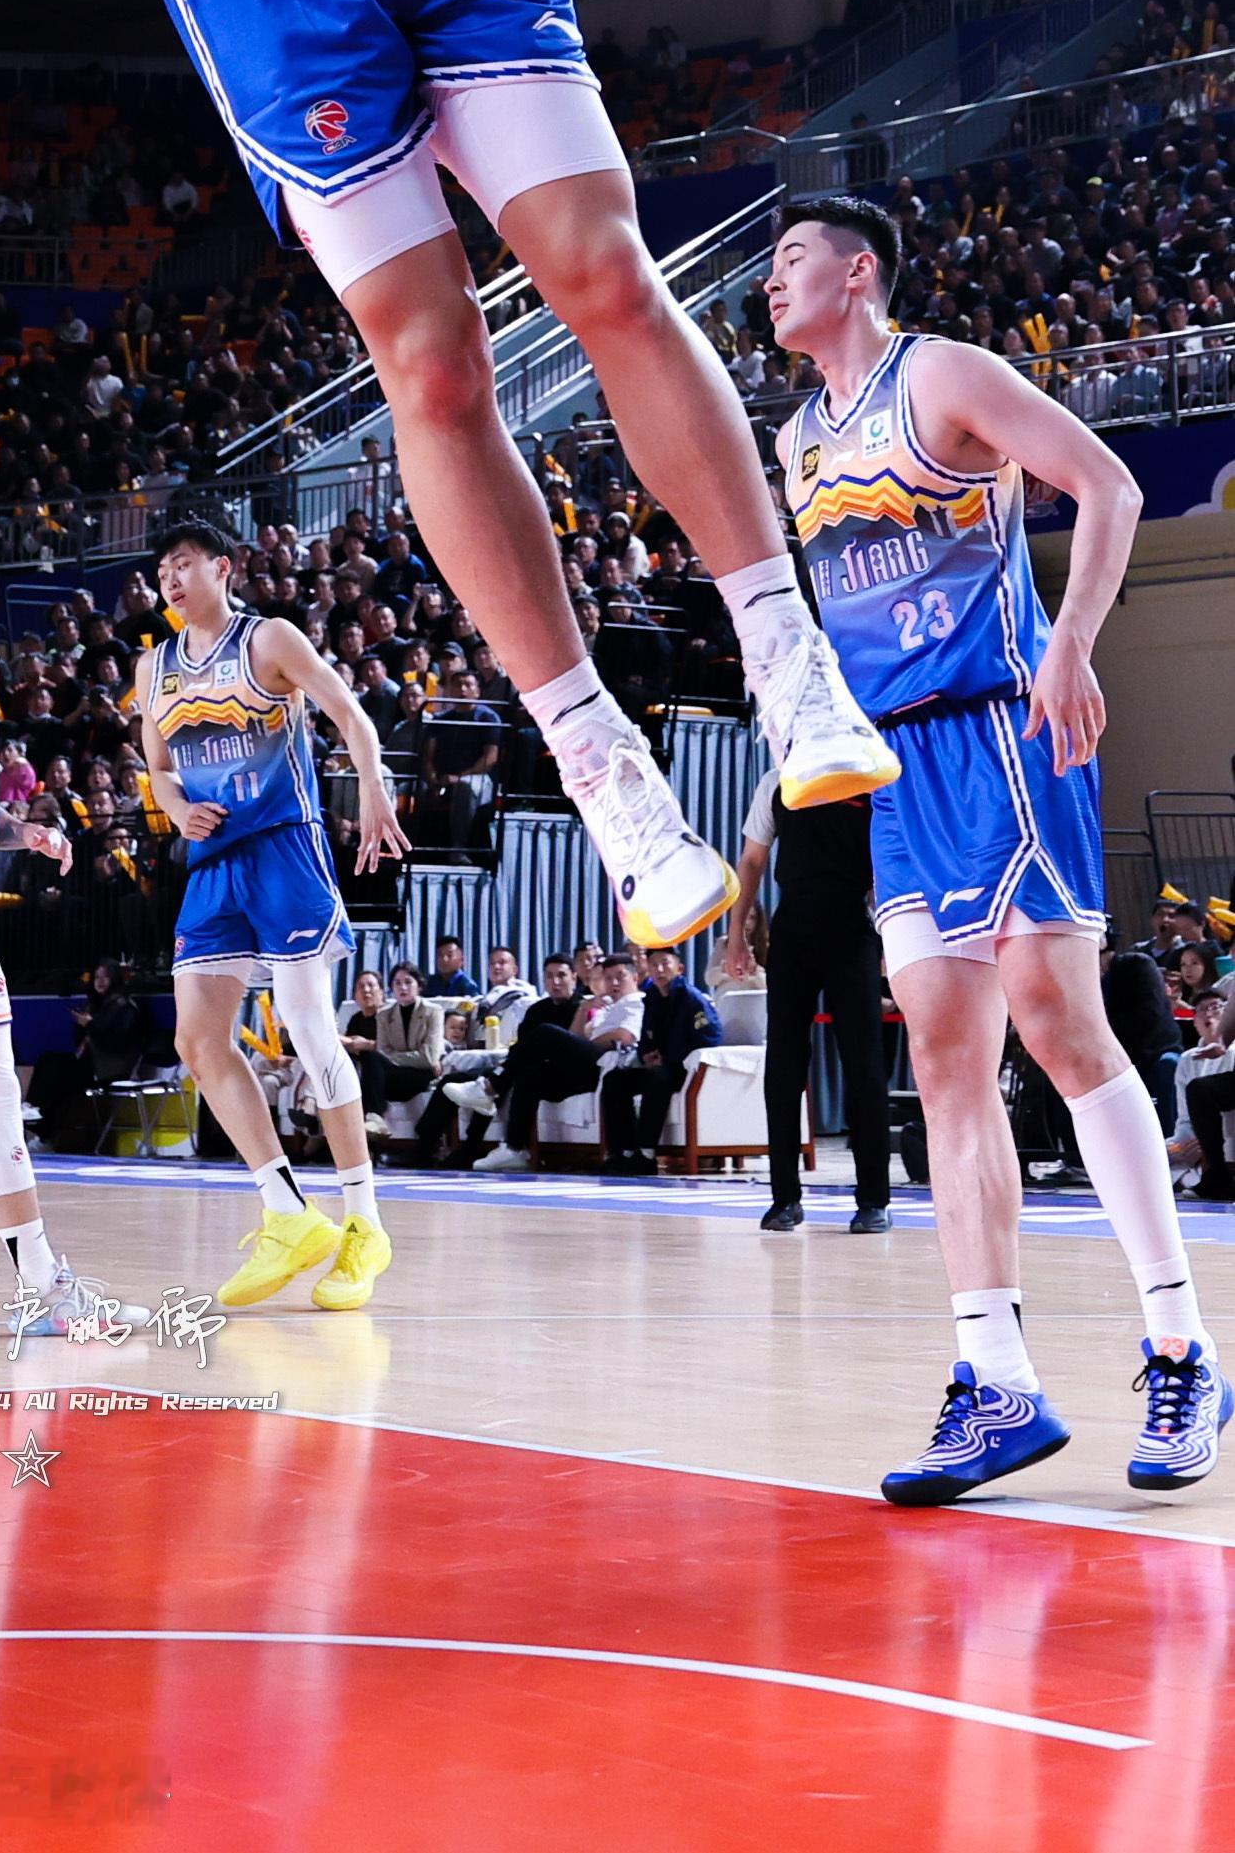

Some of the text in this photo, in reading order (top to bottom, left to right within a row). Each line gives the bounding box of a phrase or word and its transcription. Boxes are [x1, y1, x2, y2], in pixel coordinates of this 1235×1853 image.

[322, 135, 357, 156] CBA
[839, 530, 929, 593] JIANG
[889, 589, 956, 652] 23
[199, 732, 255, 766] JIANG
[232, 771, 261, 802] 11
[1158, 1336, 1187, 1357] 23
